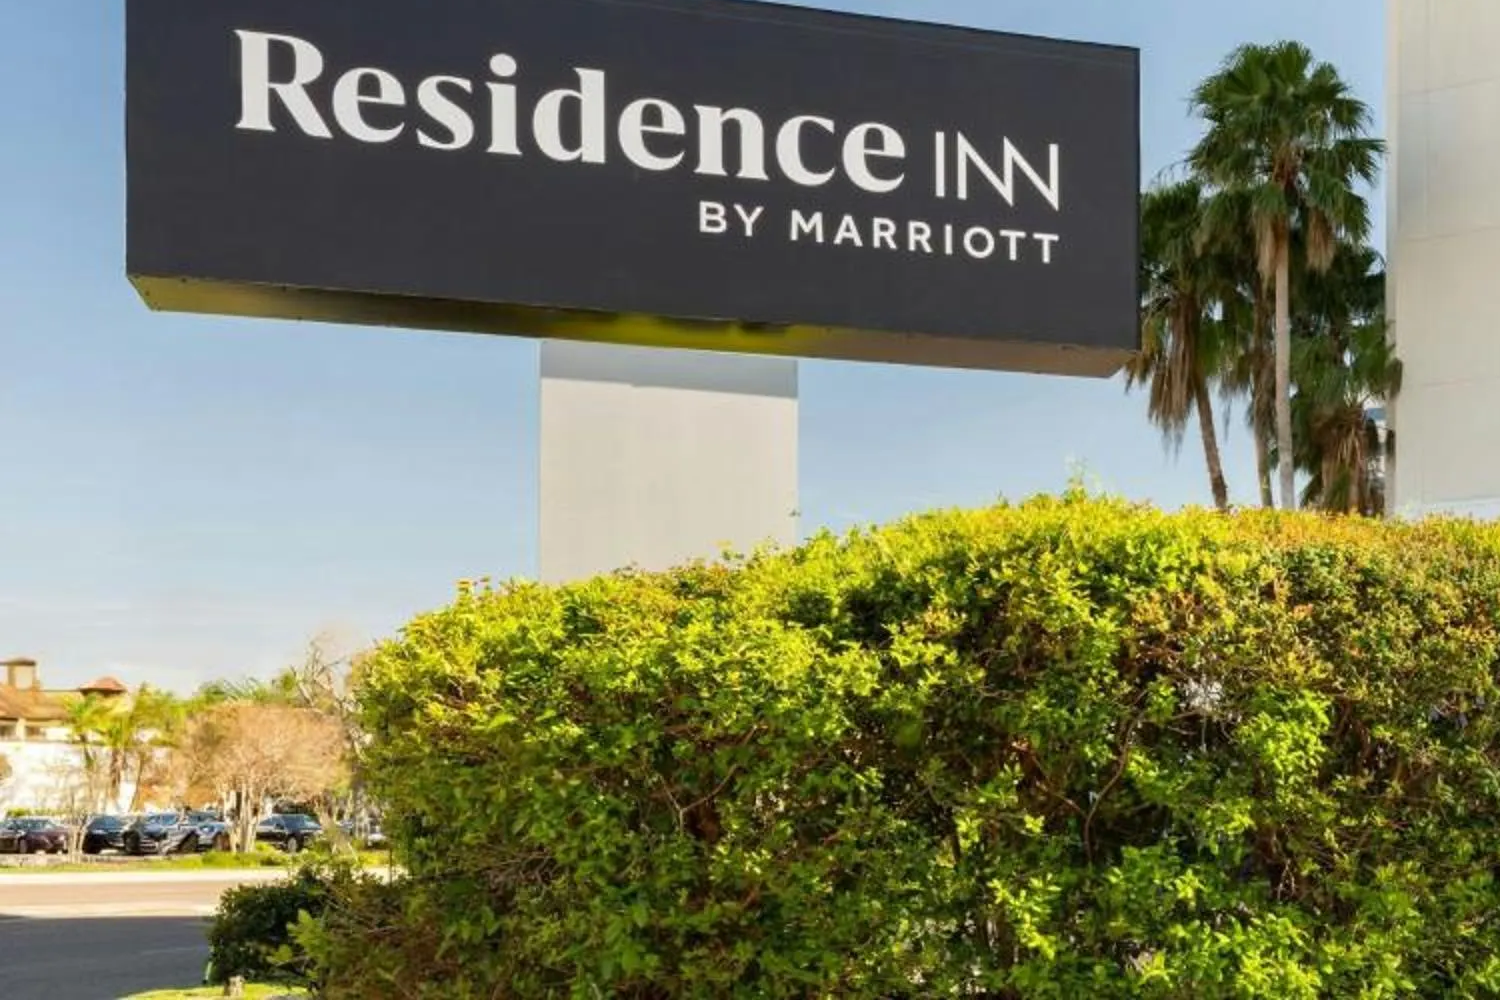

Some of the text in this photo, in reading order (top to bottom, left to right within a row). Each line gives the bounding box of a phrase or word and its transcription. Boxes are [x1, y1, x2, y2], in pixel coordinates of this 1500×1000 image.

[234, 29, 1059, 212] Residence INN
[699, 200, 1060, 264] BY MARRIOTT
